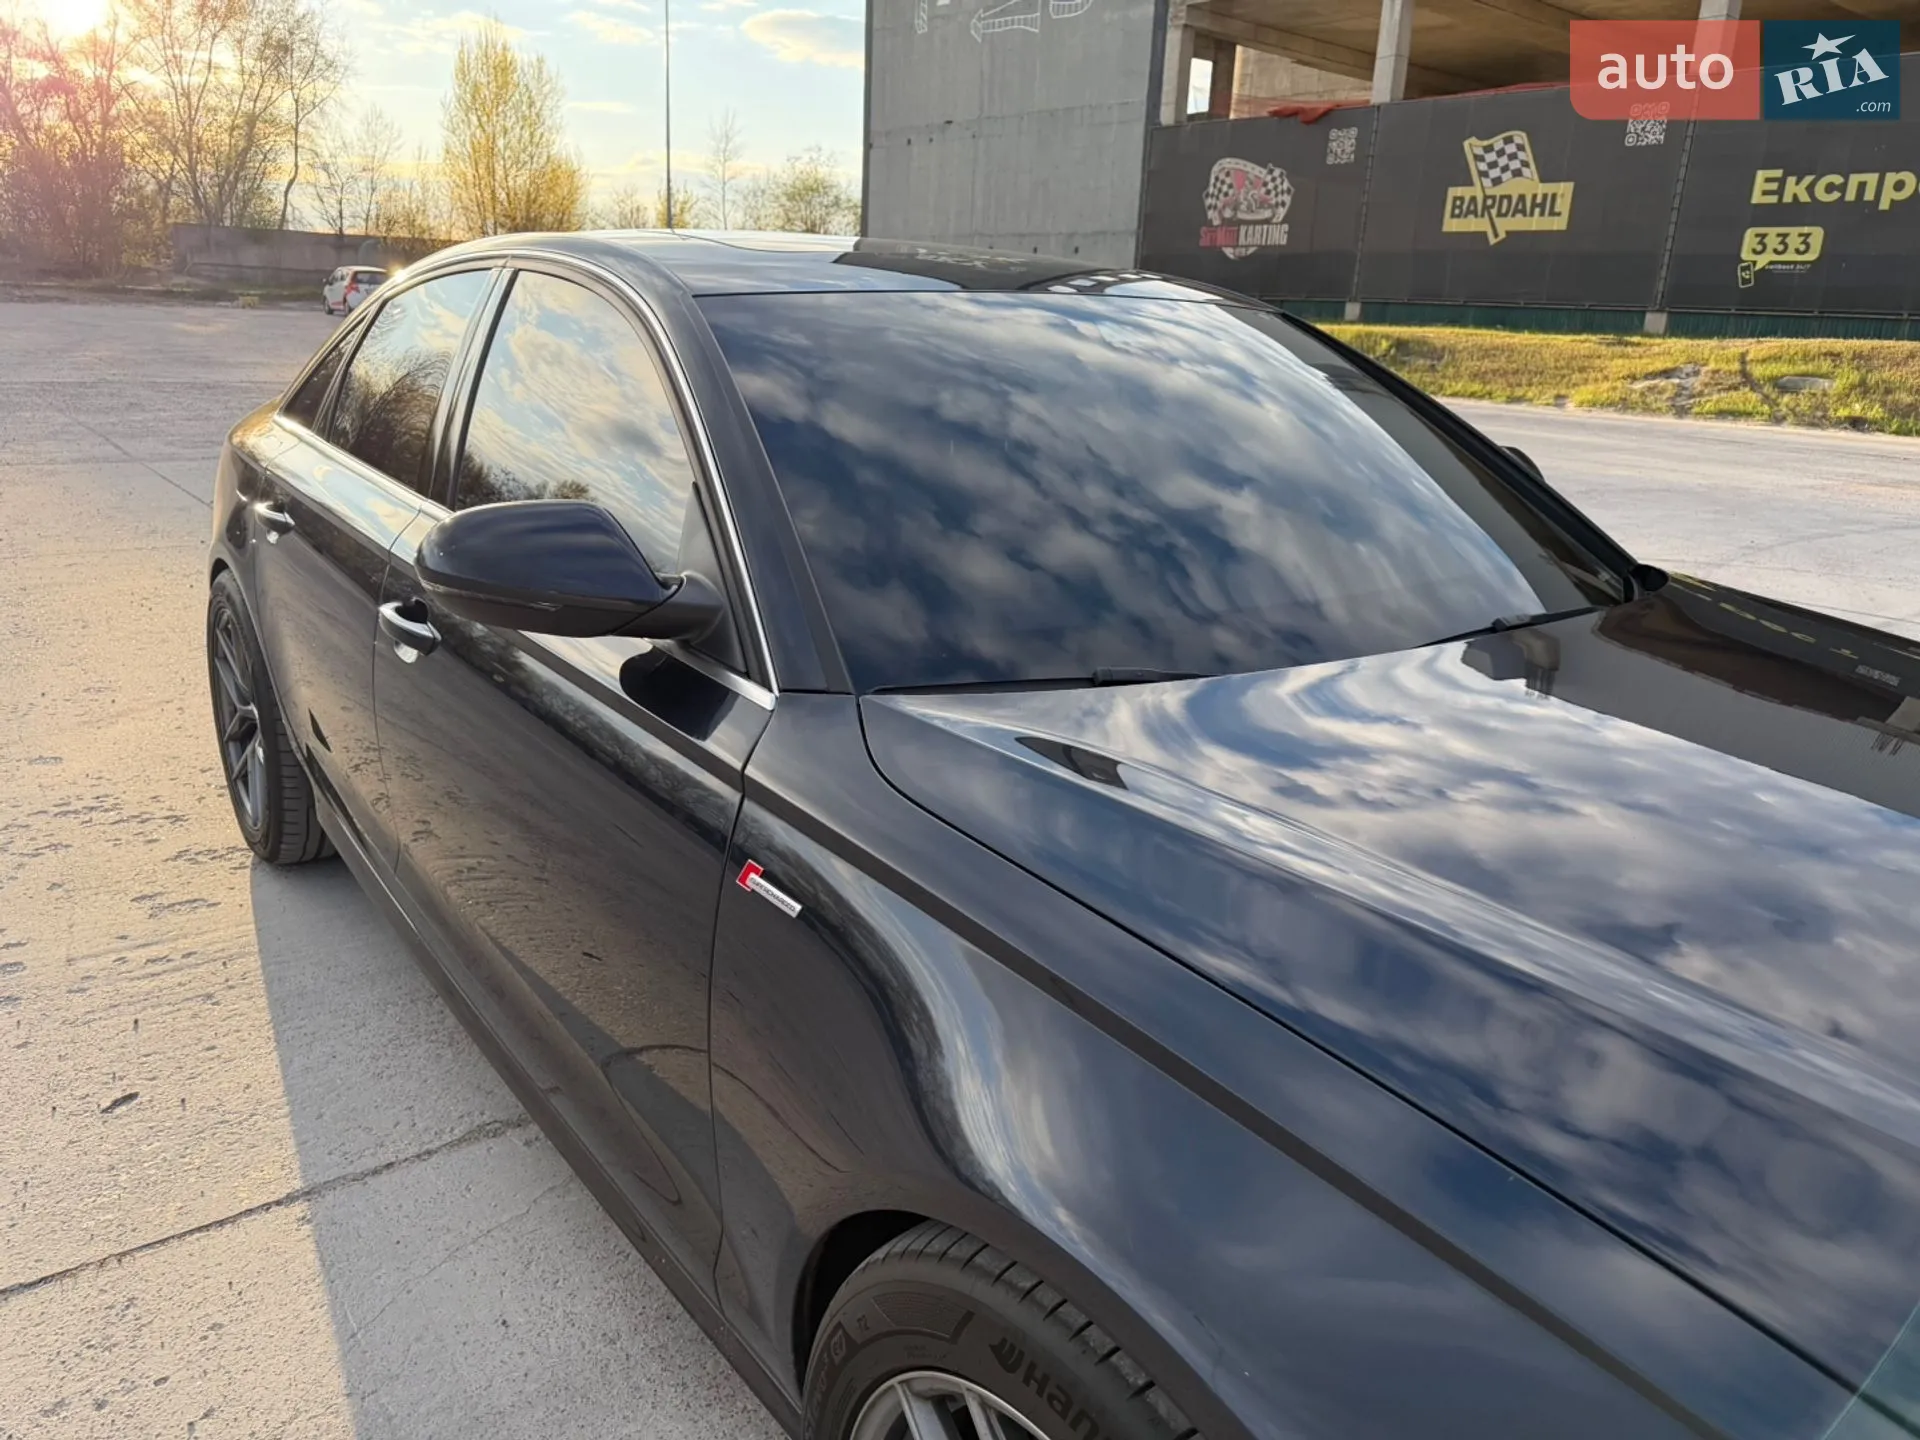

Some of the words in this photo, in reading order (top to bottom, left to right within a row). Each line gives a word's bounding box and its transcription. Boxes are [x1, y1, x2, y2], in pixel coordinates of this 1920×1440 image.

[1751, 169, 1920, 210] Експр
[1450, 192, 1562, 218] BARDAHL
[1239, 222, 1289, 246] KARTING
[1751, 232, 1813, 256] 333
[1022, 1360, 1113, 1440] Han
